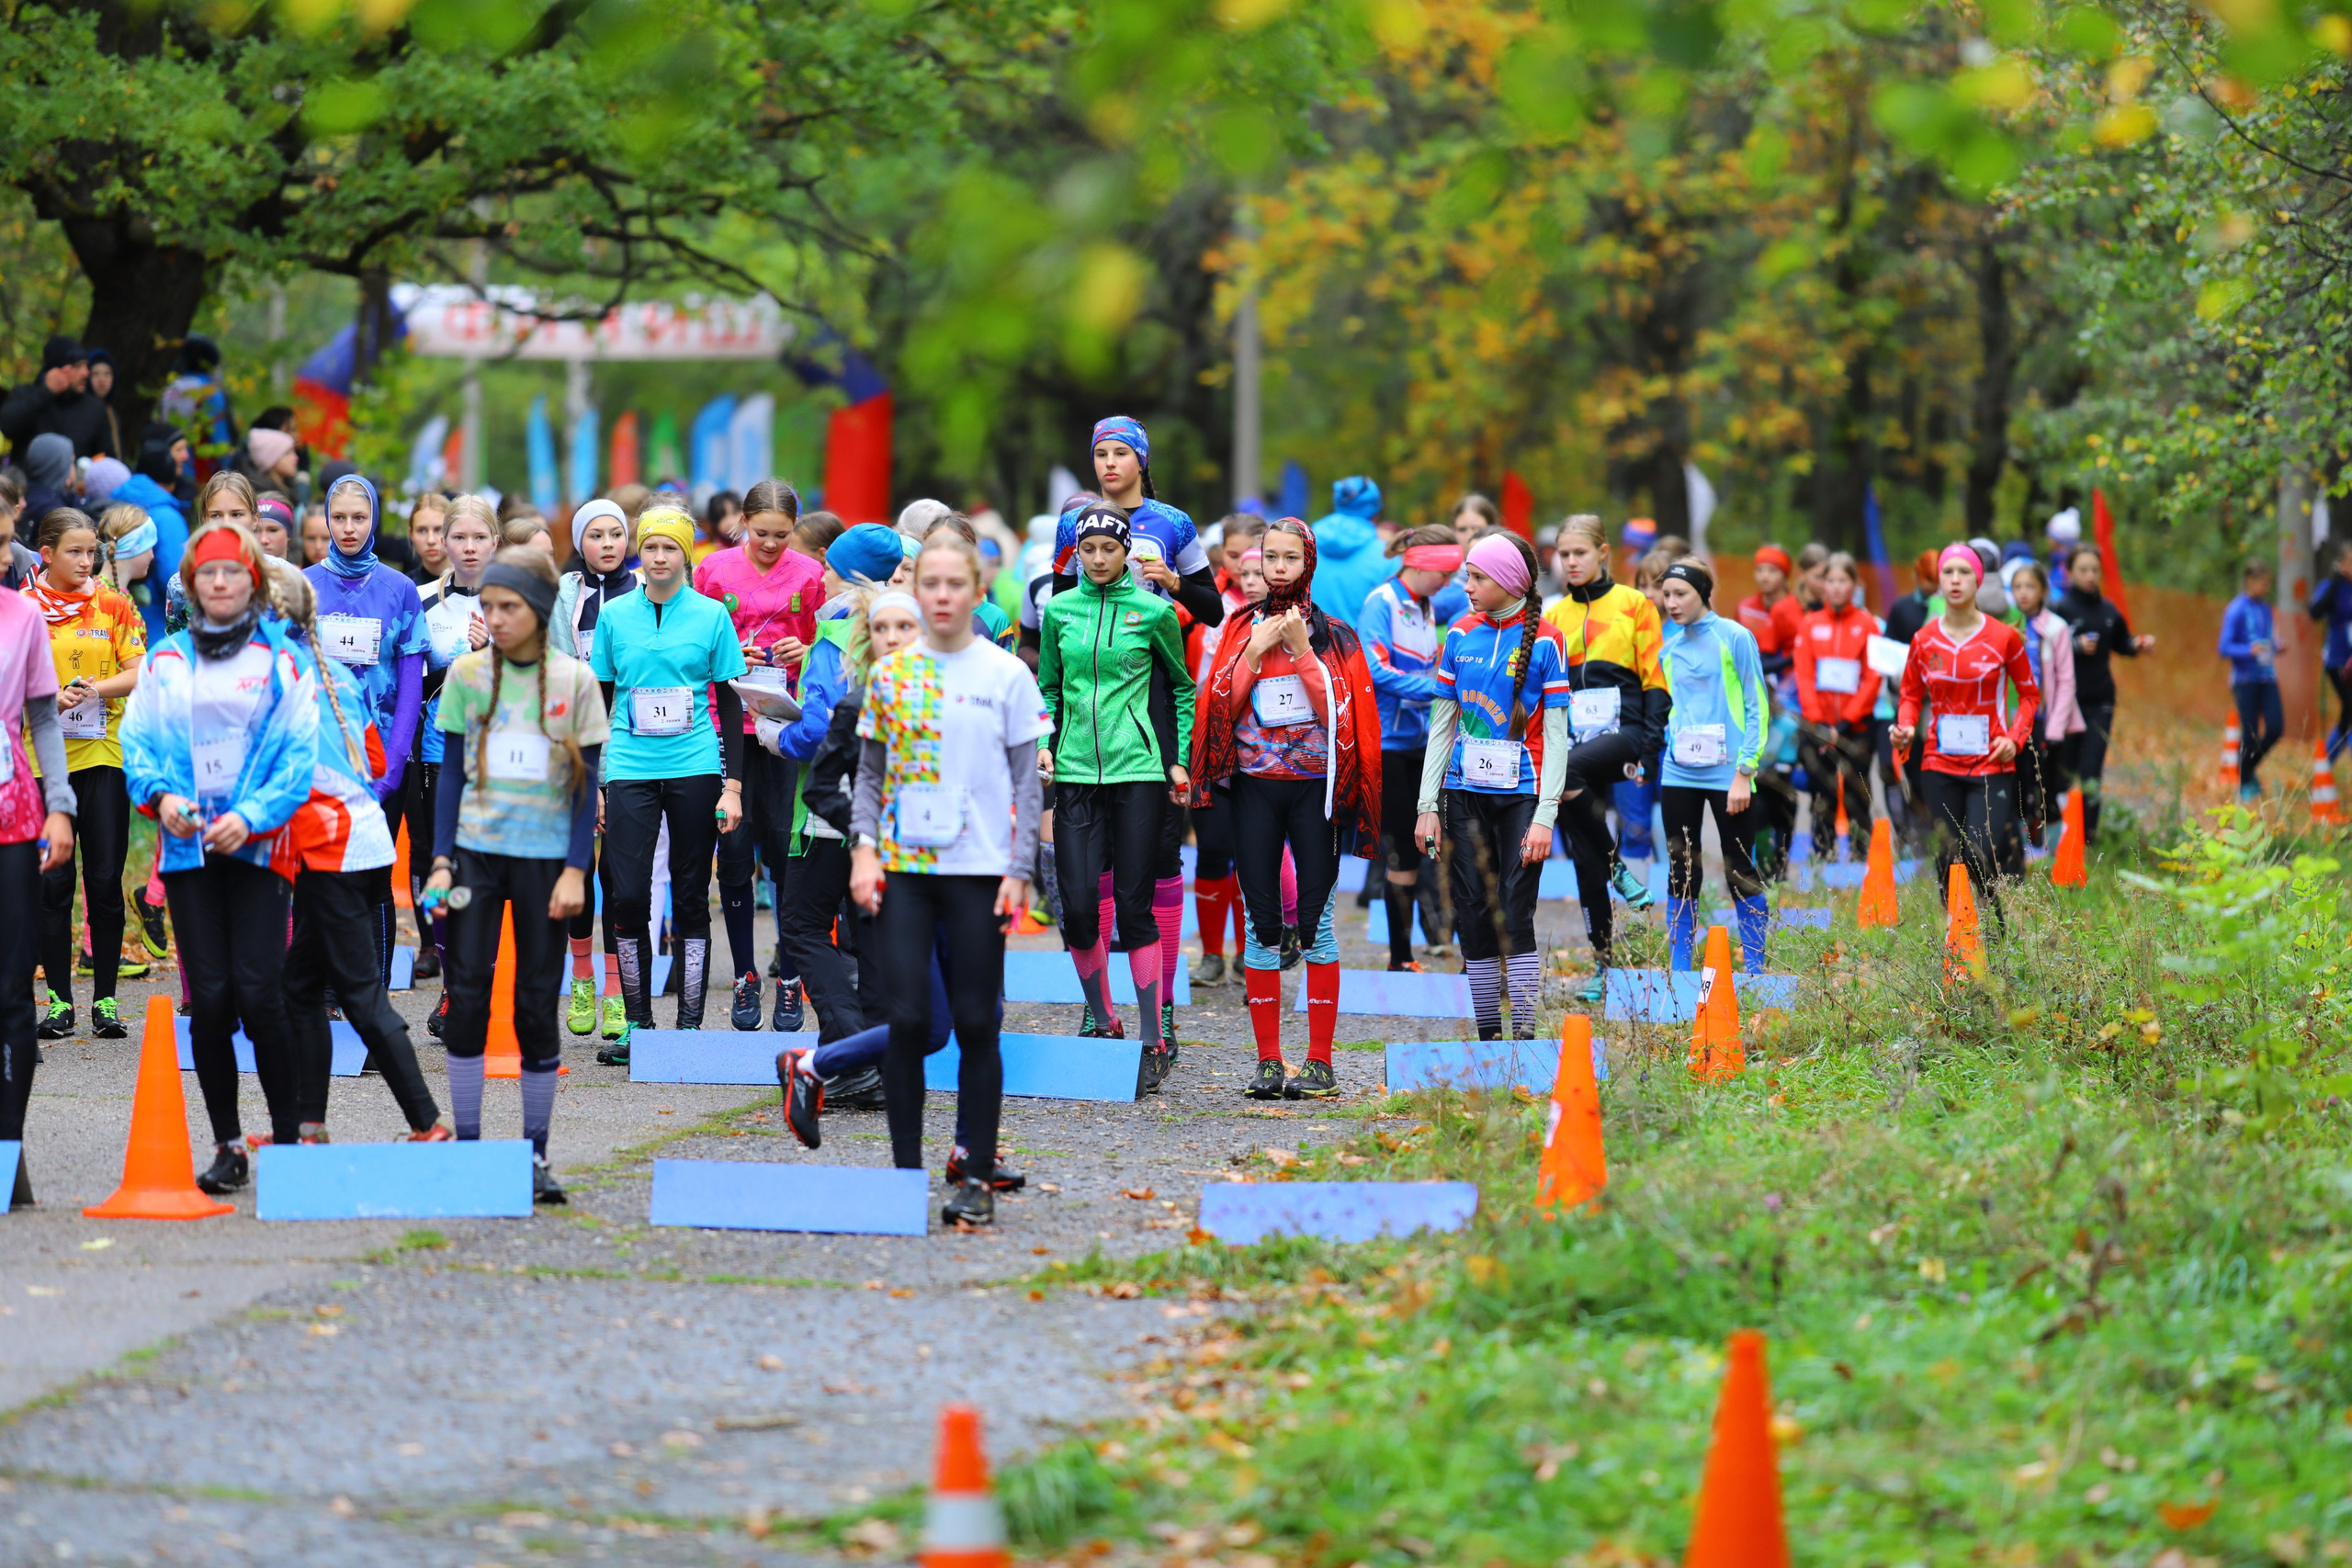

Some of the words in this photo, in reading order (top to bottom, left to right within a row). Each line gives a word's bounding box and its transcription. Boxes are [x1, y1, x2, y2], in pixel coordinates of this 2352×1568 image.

[1075, 513, 1127, 536] RAFT
[339, 635, 355, 647] 44
[1279, 693, 1294, 705] 27
[653, 705, 667, 718] 31
[1462, 689, 1508, 727] ВОРОНЕЖ
[68, 710, 84, 722] 46
[1689, 742, 1702, 753] 49
[206, 759, 222, 774] 15
[1478, 758, 1493, 770] 26
